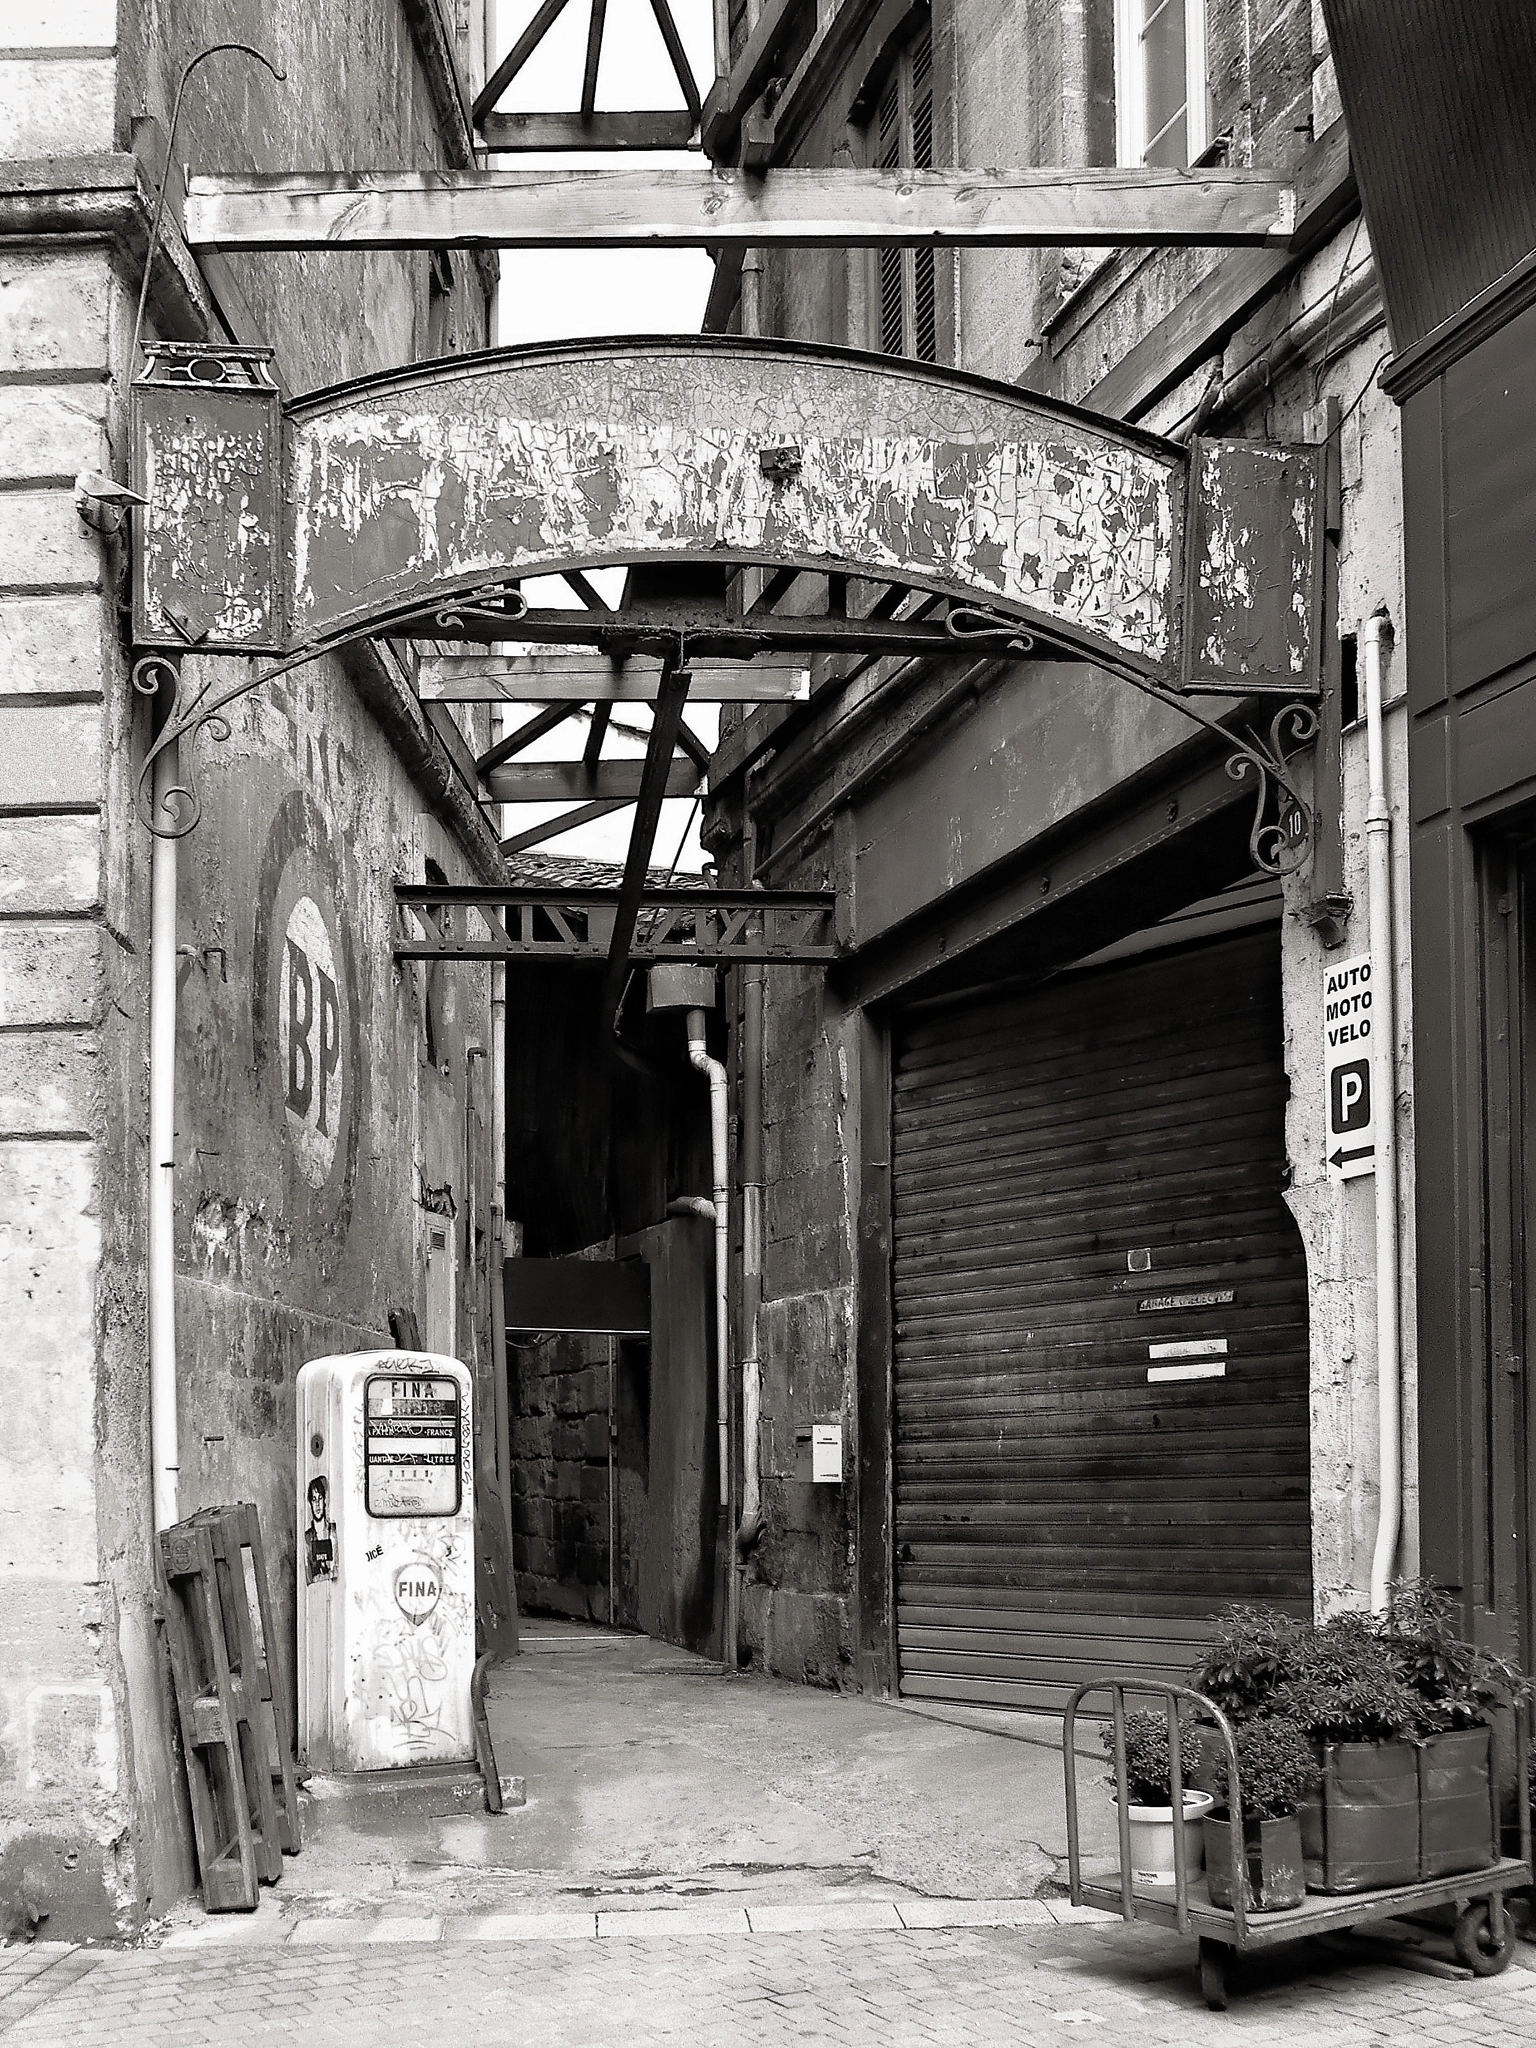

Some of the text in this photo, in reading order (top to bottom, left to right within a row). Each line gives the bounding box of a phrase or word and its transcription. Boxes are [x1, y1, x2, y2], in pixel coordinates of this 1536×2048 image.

[1289, 811, 1301, 838] 10
[1326, 963, 1371, 995] AUTO
[1326, 991, 1372, 1022] MOTO
[284, 935, 341, 1139] BP
[1328, 1019, 1371, 1047] VELO
[1341, 1072, 1363, 1123] P
[391, 1381, 434, 1398] FINA
[426, 1428, 453, 1437] FRANCS
[398, 1581, 437, 1597] FINA
